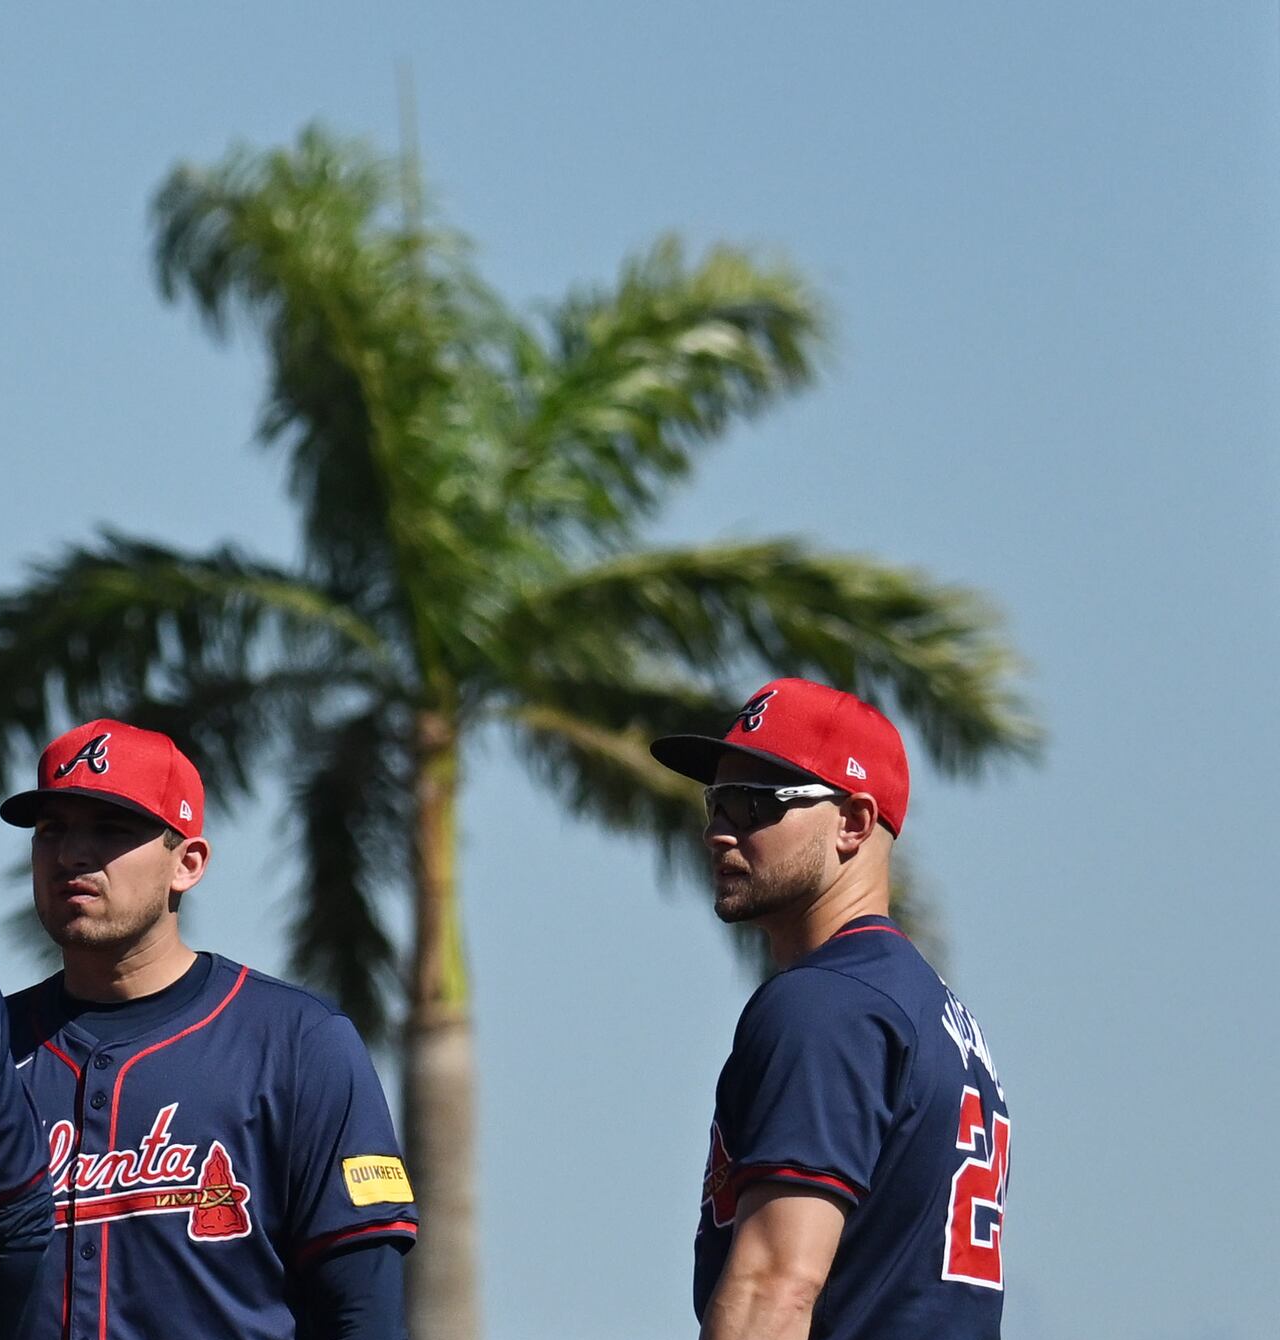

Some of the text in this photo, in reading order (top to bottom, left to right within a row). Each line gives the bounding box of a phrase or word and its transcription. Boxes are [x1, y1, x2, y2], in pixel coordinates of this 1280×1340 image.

[54, 732, 111, 779] A
[48, 1102, 198, 1197] lanta
[350, 1164, 403, 1184] QUIKRETE
